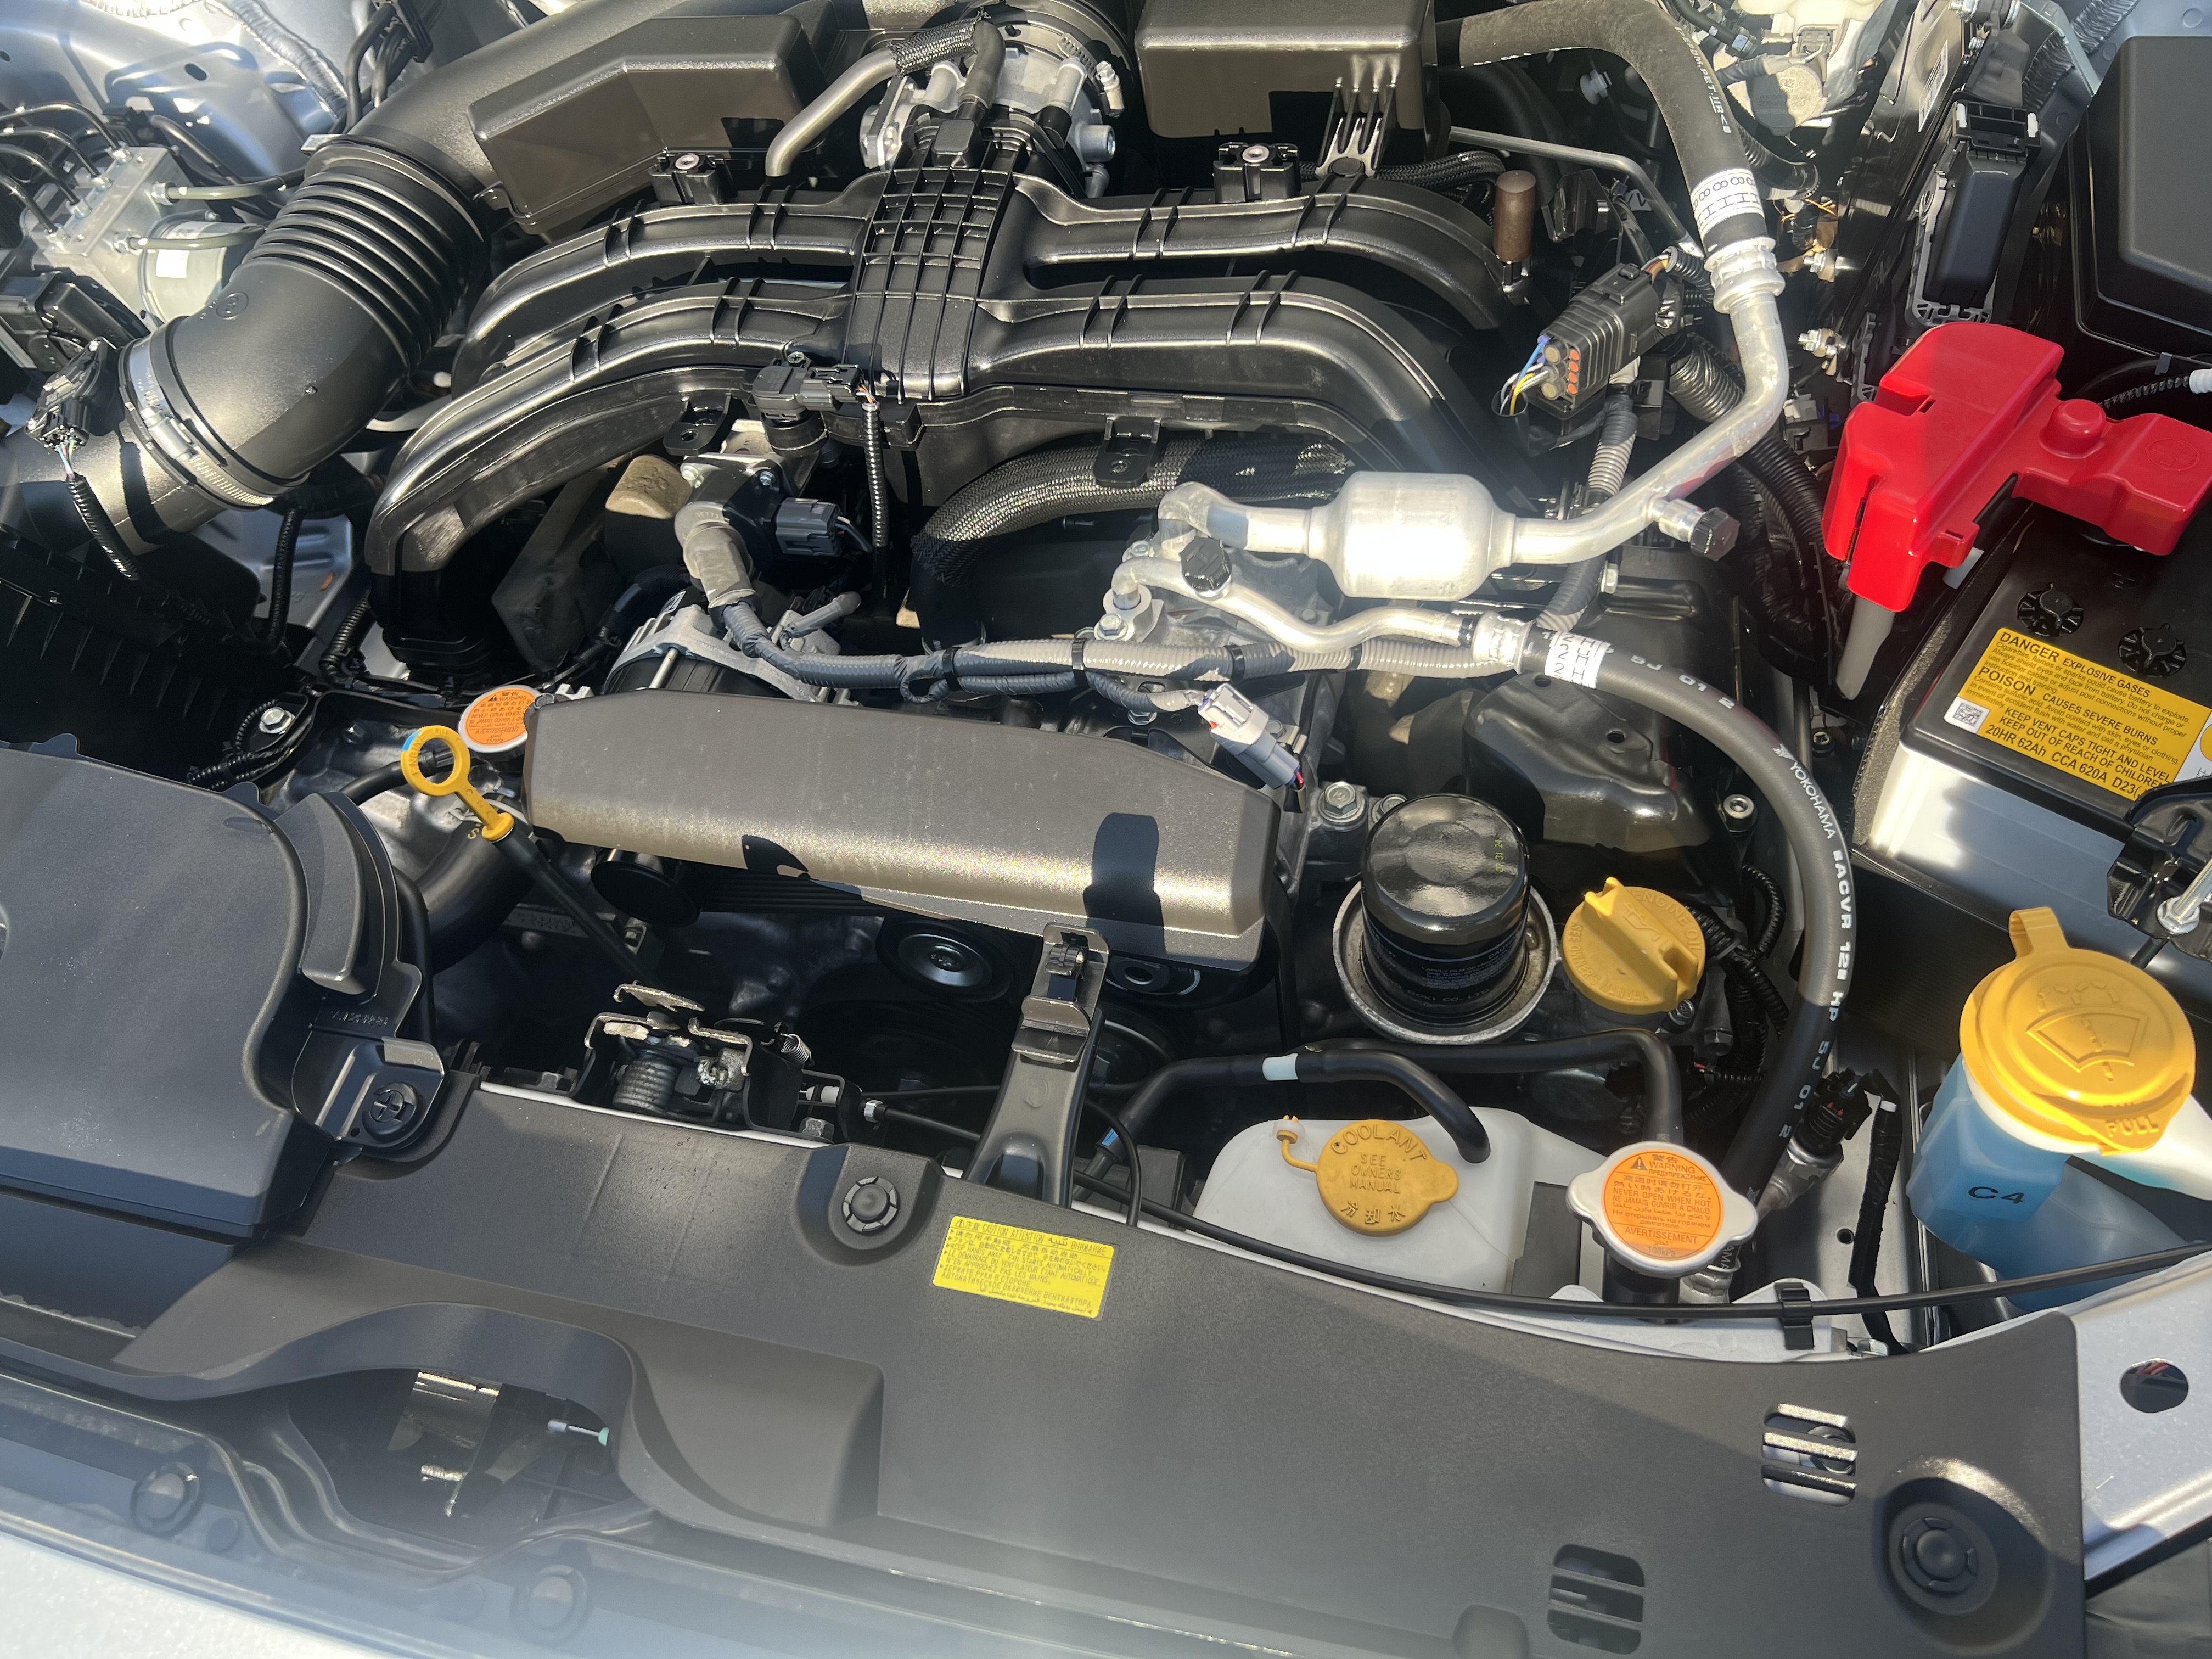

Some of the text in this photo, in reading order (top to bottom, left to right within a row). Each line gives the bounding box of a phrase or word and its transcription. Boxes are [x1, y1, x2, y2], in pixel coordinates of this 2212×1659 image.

[1553, 662, 1585, 681] 2 H
[1983, 660, 2032, 683] instruction and
[1998, 631, 2152, 698] DANGER EXPLOSIVE GASES
[1990, 647, 2016, 662] Always
[2015, 657, 2037, 669] shield
[2035, 666, 2053, 677] eyes
[2053, 671, 2068, 682] and
[2067, 677, 2084, 688] face
[2083, 683, 2101, 694] from
[2126, 700, 2138, 710] Do
[2138, 705, 2151, 715] not
[2149, 710, 2176, 726] charge
[2031, 655, 2056, 669] flames
[2062, 667, 2087, 682] sparks
[2086, 676, 2106, 689] could
[2106, 685, 2127, 697] cause
[2127, 693, 2153, 709] battery
[2153, 703, 2162, 711] to
[1977, 665, 2159, 746] POISON CAUSES SEVERE BURNS
[1987, 654, 2001, 663] use
[2000, 659, 2027, 673] booster
[2026, 669, 2050, 682] cables
[2057, 681, 2080, 696] adjust
[2079, 690, 2096, 702] post
[2095, 696, 2137, 717] connections
[2136, 713, 2163, 728] without
[2162, 725, 2187, 739] proper
[1973, 675, 2003, 691] Contains
[2002, 687, 2029, 701] sulfuric
[2044, 703, 2065, 716] Avoid
[2064, 712, 2091, 727] contact
[2091, 722, 2107, 733] with
[2122, 737, 2141, 750] eyes
[1977, 685, 1997, 697] event
[1996, 692, 2006, 700] of
[2004, 696, 2034, 711] accident
[2033, 707, 2051, 719] flush
[2050, 714, 2066, 725] with
[2065, 721, 2086, 733] water
[2085, 728, 2101, 739] and
[2100, 735, 2114, 744] call
[475, 726, 519, 735] AVERTISSEMENT
[2003, 707, 2031, 724] KEEP
[2030, 718, 2058, 735] VENT
[2057, 728, 2086, 746] CAPS
[2085, 740, 2118, 759] TIGHT
[2115, 752, 2140, 769] AND
[408, 728, 450, 775] ENGINE OIL
[1984, 723, 2018, 744] 20HR
[2016, 736, 2048, 757] 62Ah
[2048, 750, 2080, 770] CCA
[2078, 761, 2110, 783] 620A
[1998, 715, 2164, 791] KEEP OUT OF REACH OF CHILDRE
[1495, 852, 1504, 860] 31
[1495, 863, 1504, 873] 07
[1790, 761, 1835, 839] YOKOHAMA
[1829, 991, 1844, 1021] HP
[1632, 889, 1702, 951] ENGINE OIL
[1568, 922, 1650, 1002] SEE OWNER'S MANUAL
[2105, 1116, 2160, 1138] PULL
[1331, 1124, 1427, 1160] COOLANT
[1360, 1153, 1386, 1166] SEE
[1648, 1160, 1696, 1174] WARNING
[1351, 1164, 1401, 1181] OWNERS
[1349, 1180, 1401, 1194] MANUAL
[1613, 1187, 1638, 1197] NEVER
[1642, 1191, 1663, 1201] OPEN
[1666, 1195, 1691, 1205] WHEN
[1968, 1186, 2025, 1204] C4
[1623, 1196, 1648, 1206] JAMAIS
[1651, 1200, 1676, 1210] OUVRIR
[981, 1223, 1008, 1236] CAUTION
[1010, 1228, 1045, 1243] ATTENTION
[1070, 1240, 1107, 1256] ВНИМАНИЕ
[1624, 1225, 1698, 1244] AVERTISSEMENT
[947, 1249, 957, 1257] LE
[1000, 1259, 1038, 1274] VENTILATEUR
[950, 1242, 965, 1251] KEEP
[967, 1246, 985, 1255] HANDS
[1021, 1257, 1043, 1267] STARTS
[963, 1260, 997, 1273] APPROCHEZ
[999, 1267, 1012, 1276] PAS
[1014, 1270, 1026, 1279] LES
